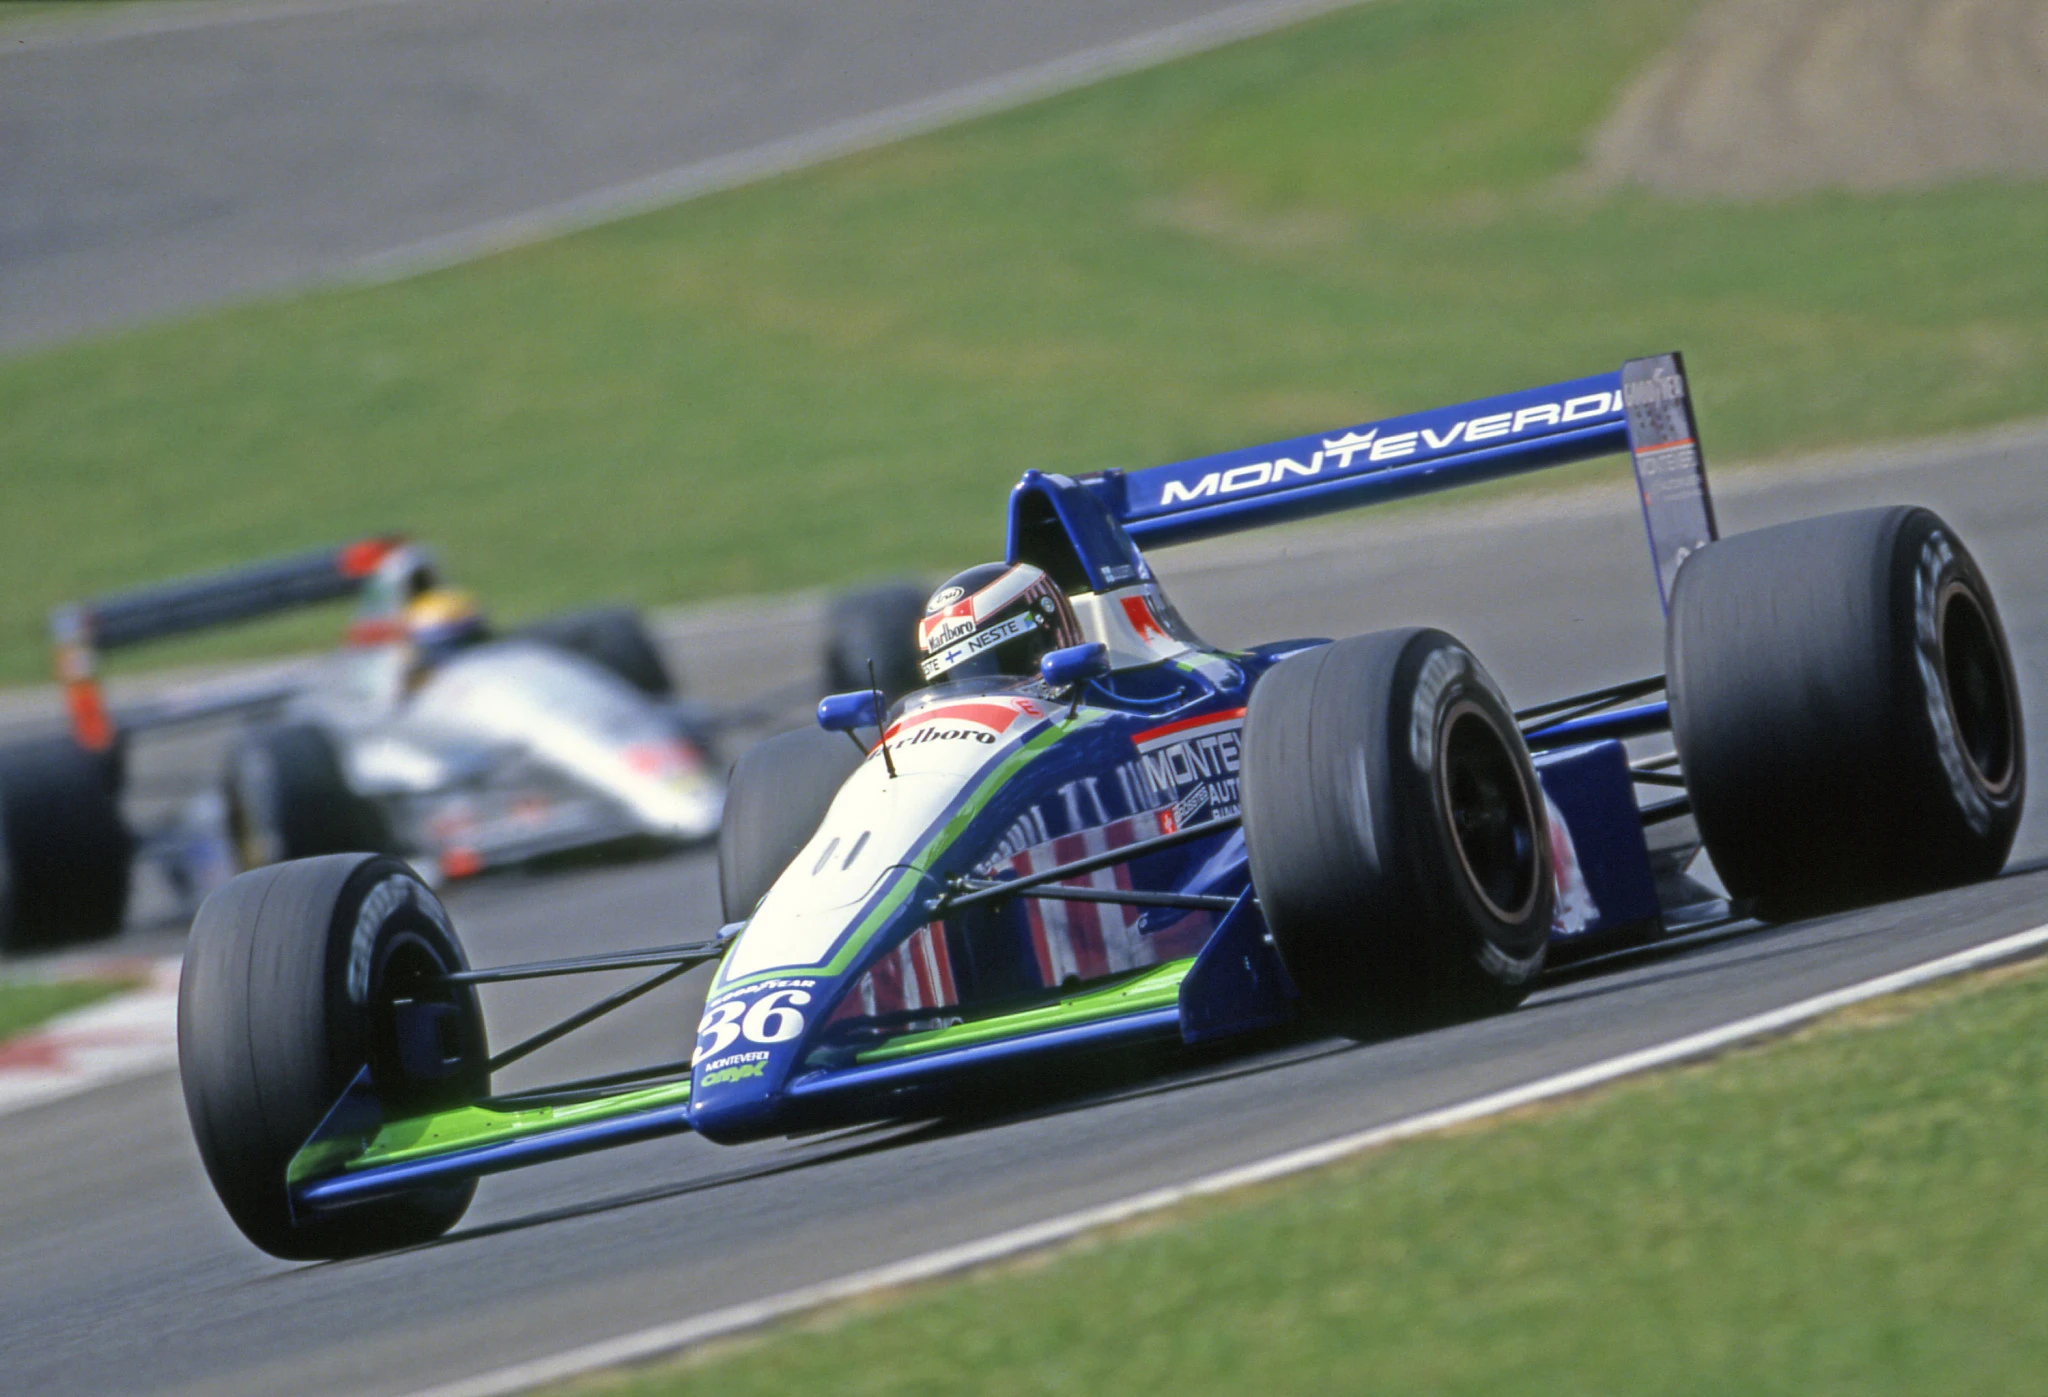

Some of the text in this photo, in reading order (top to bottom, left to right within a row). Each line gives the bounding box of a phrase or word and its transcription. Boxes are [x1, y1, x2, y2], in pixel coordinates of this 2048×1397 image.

[1160, 389, 1624, 505] MONTEVERDI
[928, 621, 974, 651] Marlboro
[968, 620, 1020, 653] NESTE
[1209, 777, 1241, 806] AUT
[691, 989, 811, 1068] 36
[705, 1051, 770, 1073] MONTEVERDI
